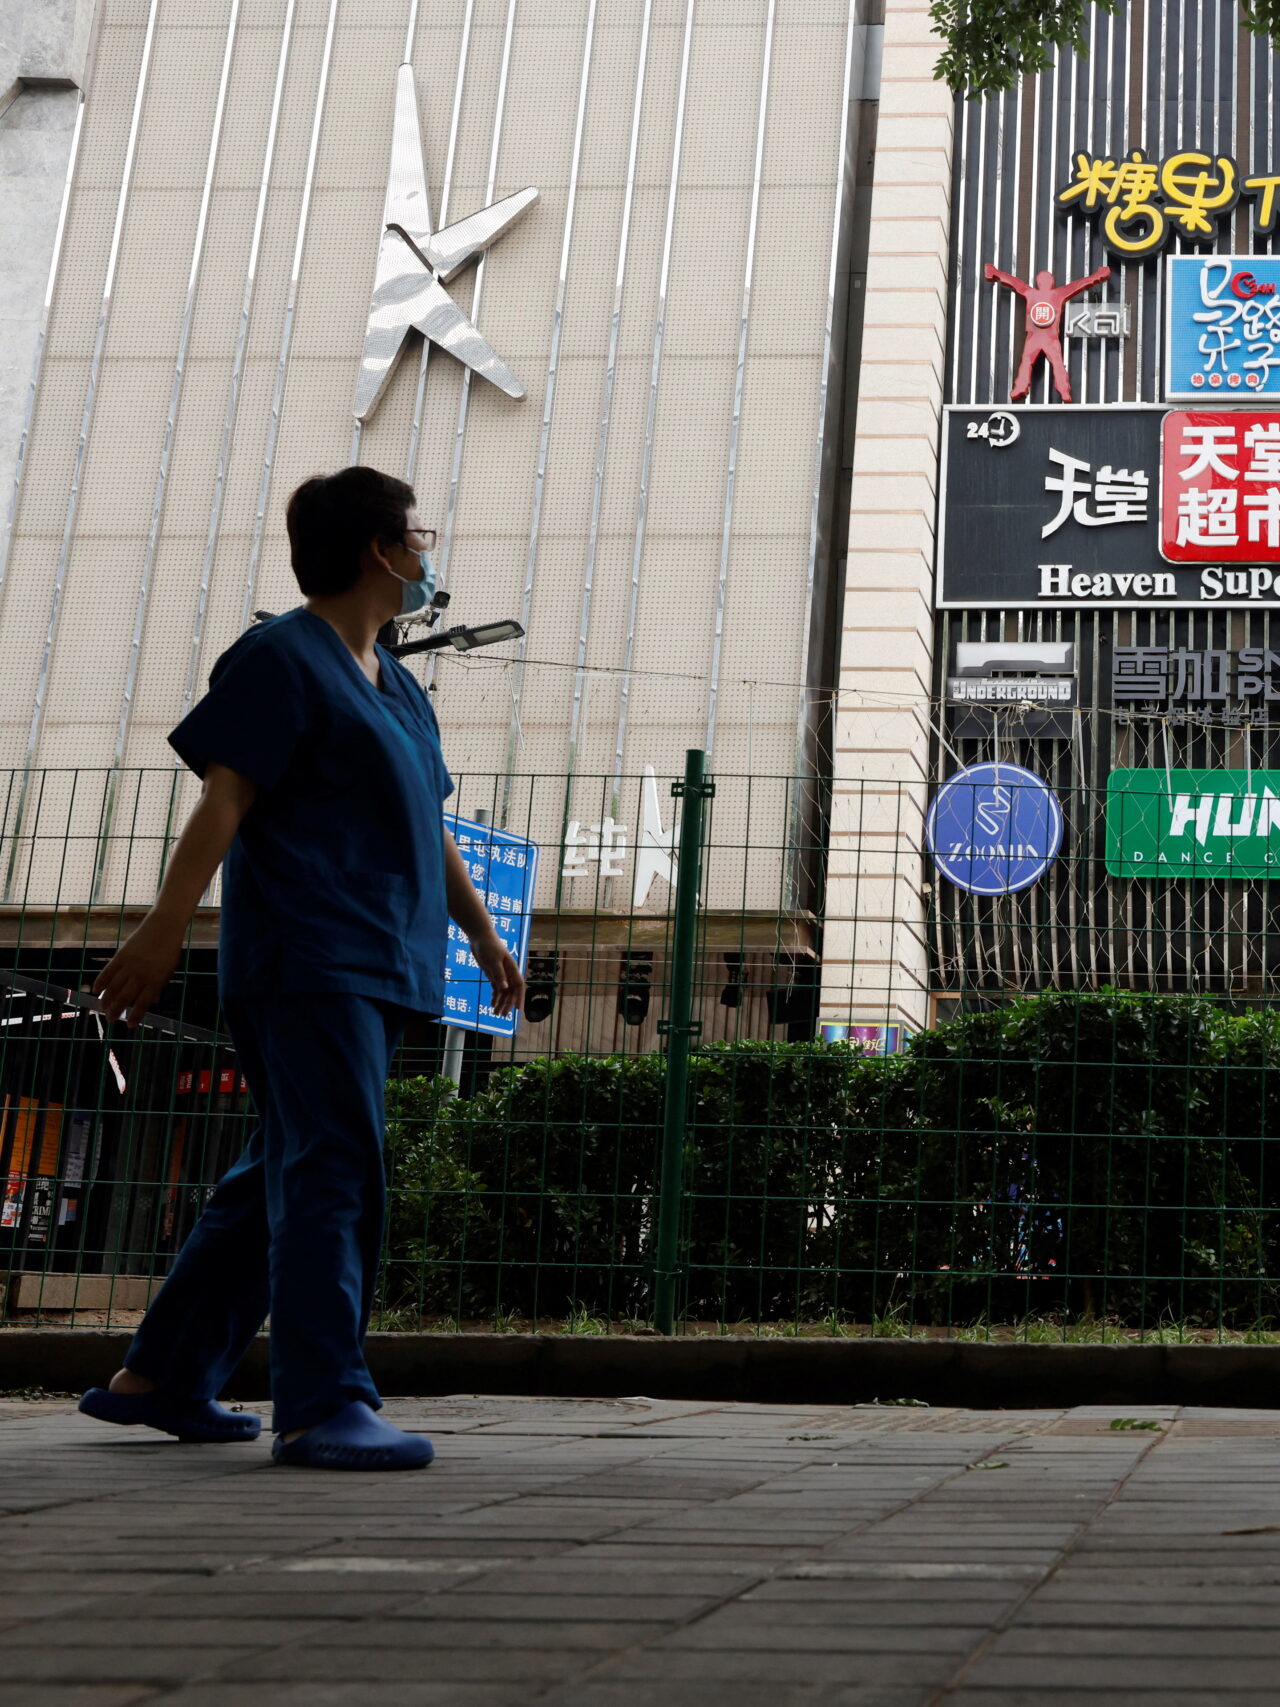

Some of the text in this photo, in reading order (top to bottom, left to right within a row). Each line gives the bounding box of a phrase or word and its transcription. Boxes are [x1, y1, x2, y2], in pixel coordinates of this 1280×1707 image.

[1059, 152, 1235, 251] 糖果
[1041, 446, 1149, 540] 天堂
[1037, 564, 1178, 597] Heaven
[1113, 646, 1228, 700] 雪加
[448, 831, 529, 870] 里屯执法队
[948, 842, 1039, 862] ZOOMIN
[1133, 851, 1234, 864] DANCE
